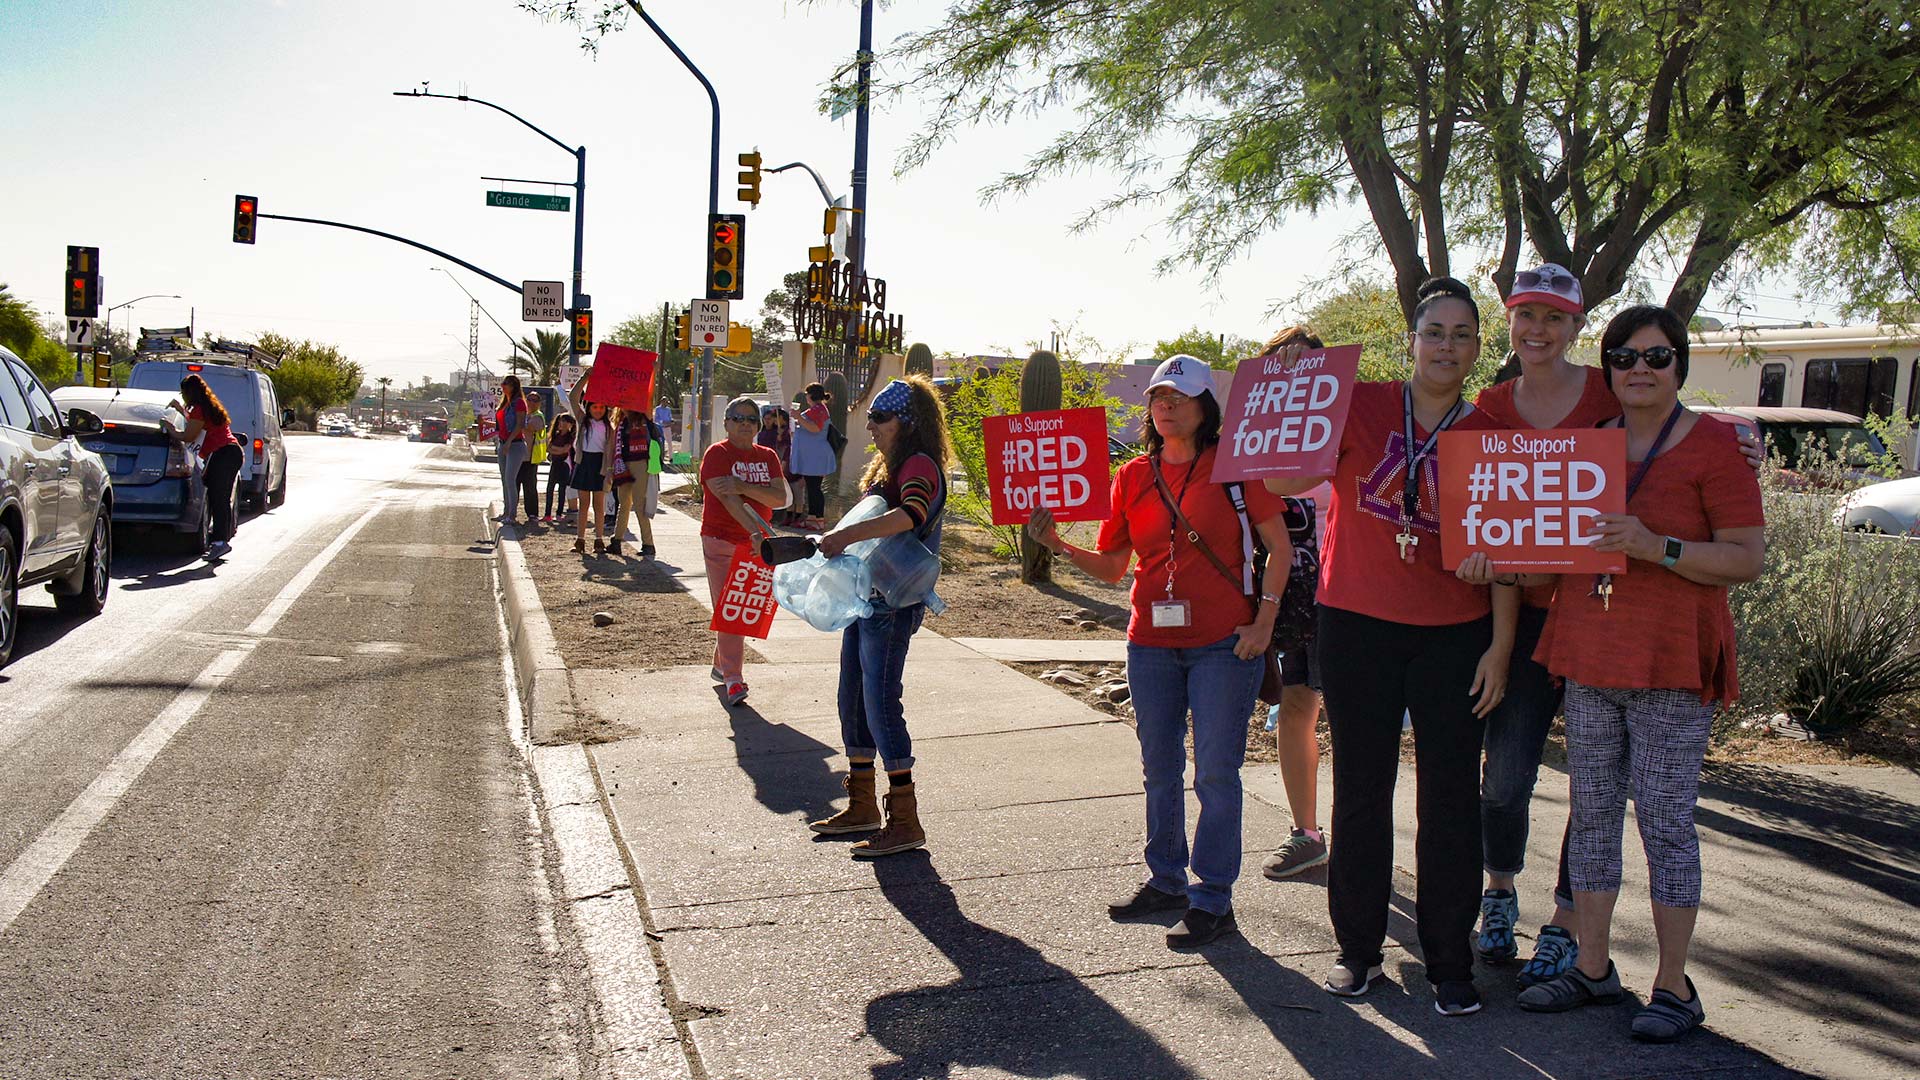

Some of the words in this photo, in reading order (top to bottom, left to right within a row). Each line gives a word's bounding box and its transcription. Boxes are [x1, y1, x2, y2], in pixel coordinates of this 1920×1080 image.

[495, 193, 530, 207] Grande
[536, 286, 550, 295] NO
[531, 297, 556, 305] TURN
[701, 303, 719, 313] NO
[525, 307, 538, 316] ON
[542, 308, 561, 317] RED
[700, 314, 721, 323] TURN
[694, 324, 706, 332] ON
[708, 324, 725, 333] RED
[1164, 360, 1184, 376] A
[1263, 357, 1282, 375] We
[490, 387, 503, 396] 35
[1244, 374, 1339, 417] #RED
[1008, 418, 1022, 434] We
[1024, 415, 1064, 436] Support
[1233, 415, 1332, 457] forED
[1002, 435, 1087, 473] #RED
[1481, 434, 1508, 454] We
[1512, 433, 1576, 460] Support
[1467, 461, 1607, 502] #RED
[1003, 473, 1090, 510] forED
[1461, 504, 1606, 546] forED
[721, 560, 758, 622] forED
[741, 567, 774, 625] #RED
